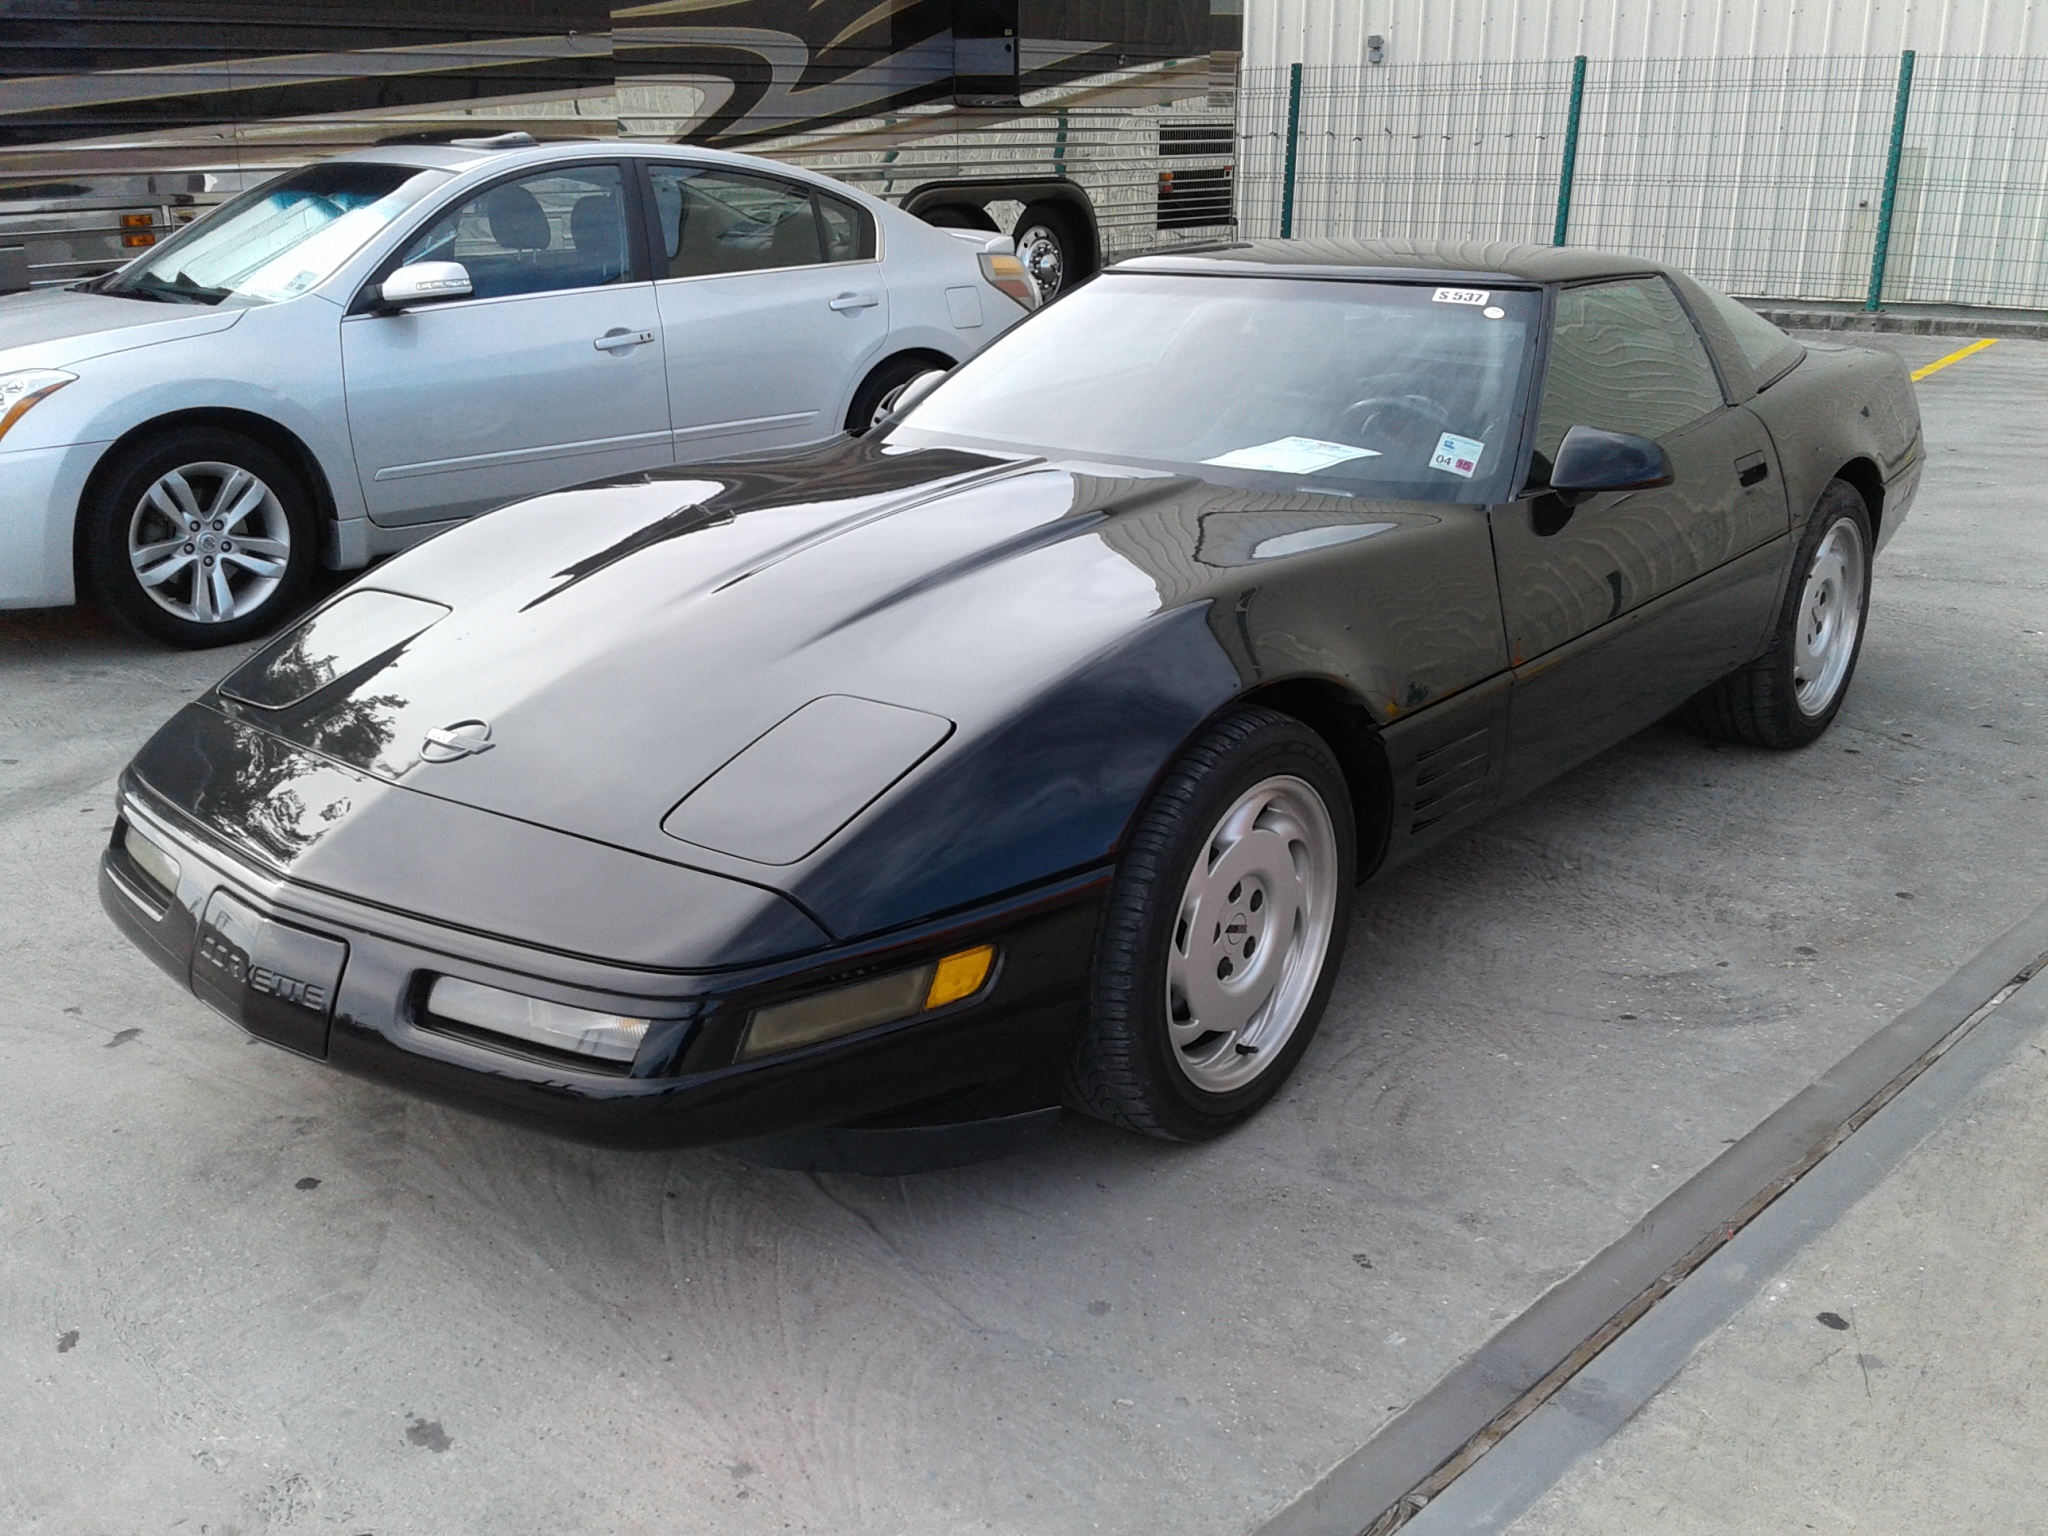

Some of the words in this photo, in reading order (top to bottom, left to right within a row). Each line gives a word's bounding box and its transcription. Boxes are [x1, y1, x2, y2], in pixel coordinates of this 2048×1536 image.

[1438, 291, 1450, 300] S
[1452, 292, 1483, 302] 537
[1436, 454, 1452, 466] 04
[200, 935, 326, 1013] CORVETTE
